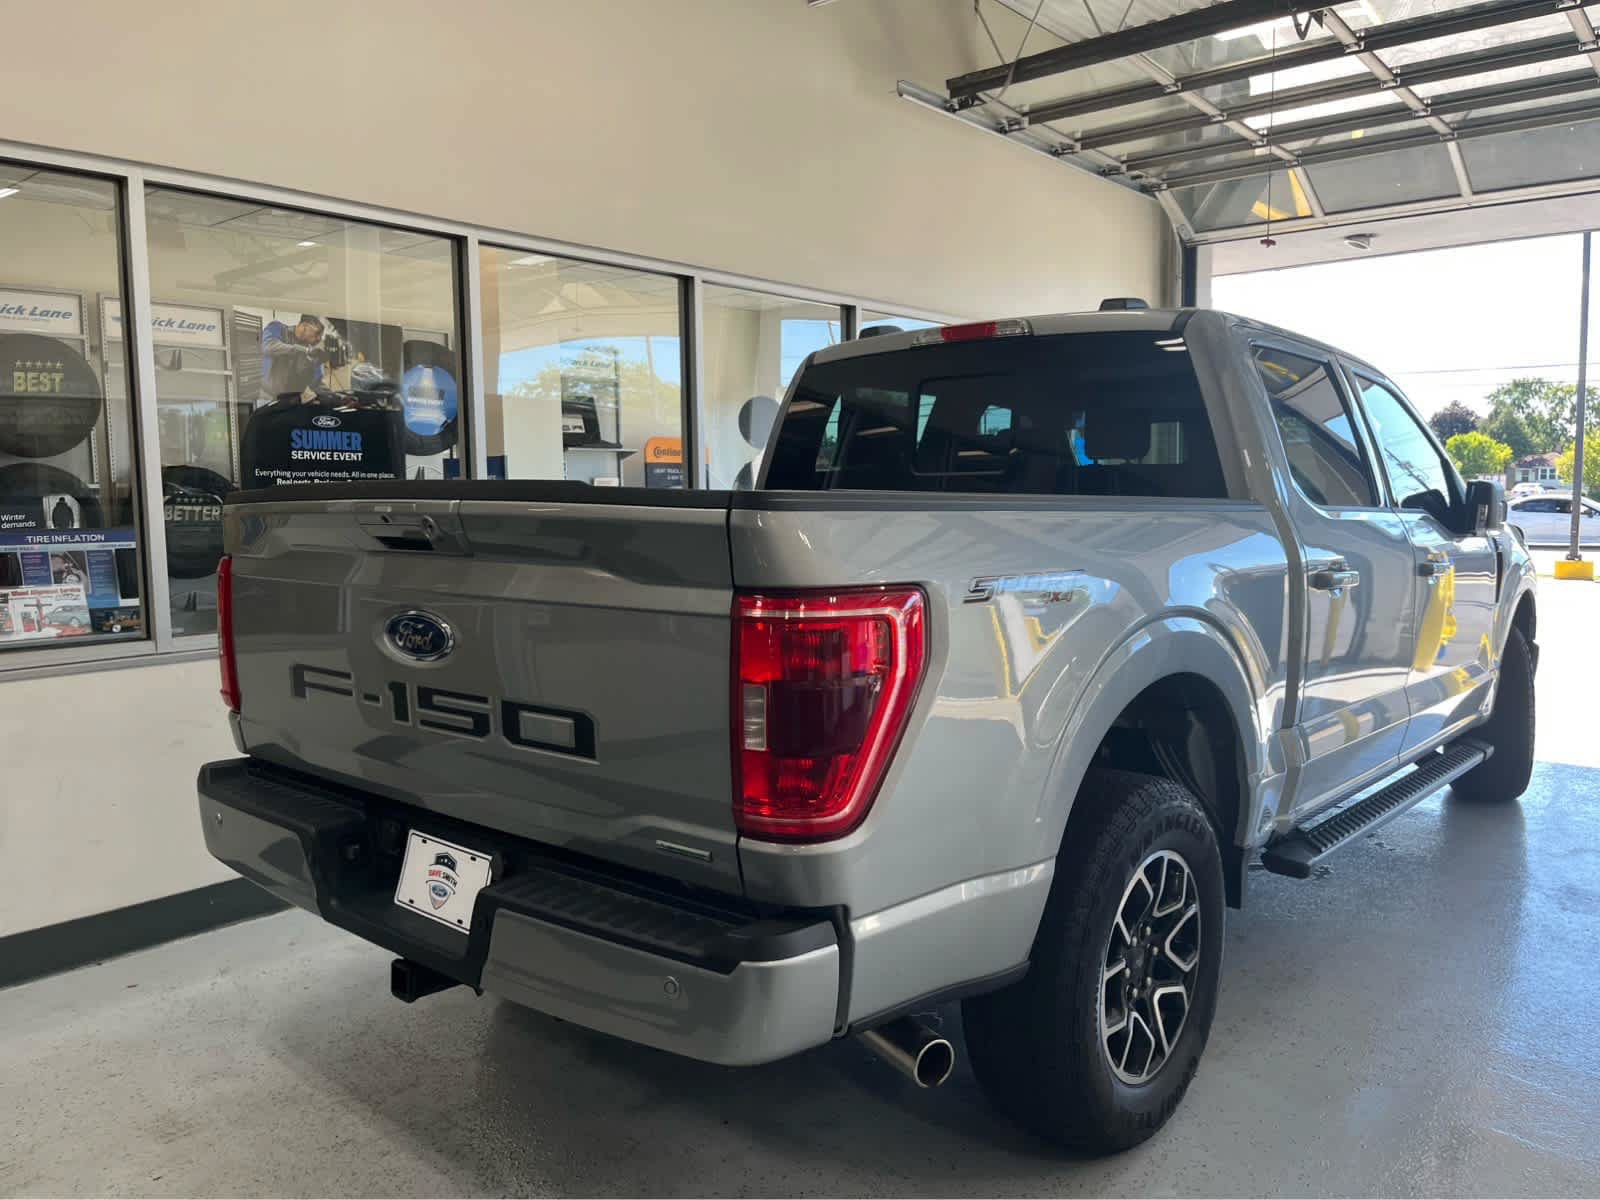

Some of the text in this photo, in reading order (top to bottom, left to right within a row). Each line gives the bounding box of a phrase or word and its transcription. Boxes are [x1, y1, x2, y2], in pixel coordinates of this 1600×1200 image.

[29, 306, 73, 320] Lane
[178, 319, 217, 332] Lane
[13, 371, 64, 392] BEST
[291, 429, 362, 450] SUMMER
[291, 450, 363, 461] SERVICE EVENT
[255, 468, 291, 478] Everything
[1, 513, 26, 522] Winter
[165, 505, 222, 521] BETTER
[1, 520, 36, 529] demands
[26, 534, 105, 543] TIRE INFLATION
[395, 620, 433, 650] Ford
[290, 663, 599, 764] F-150
